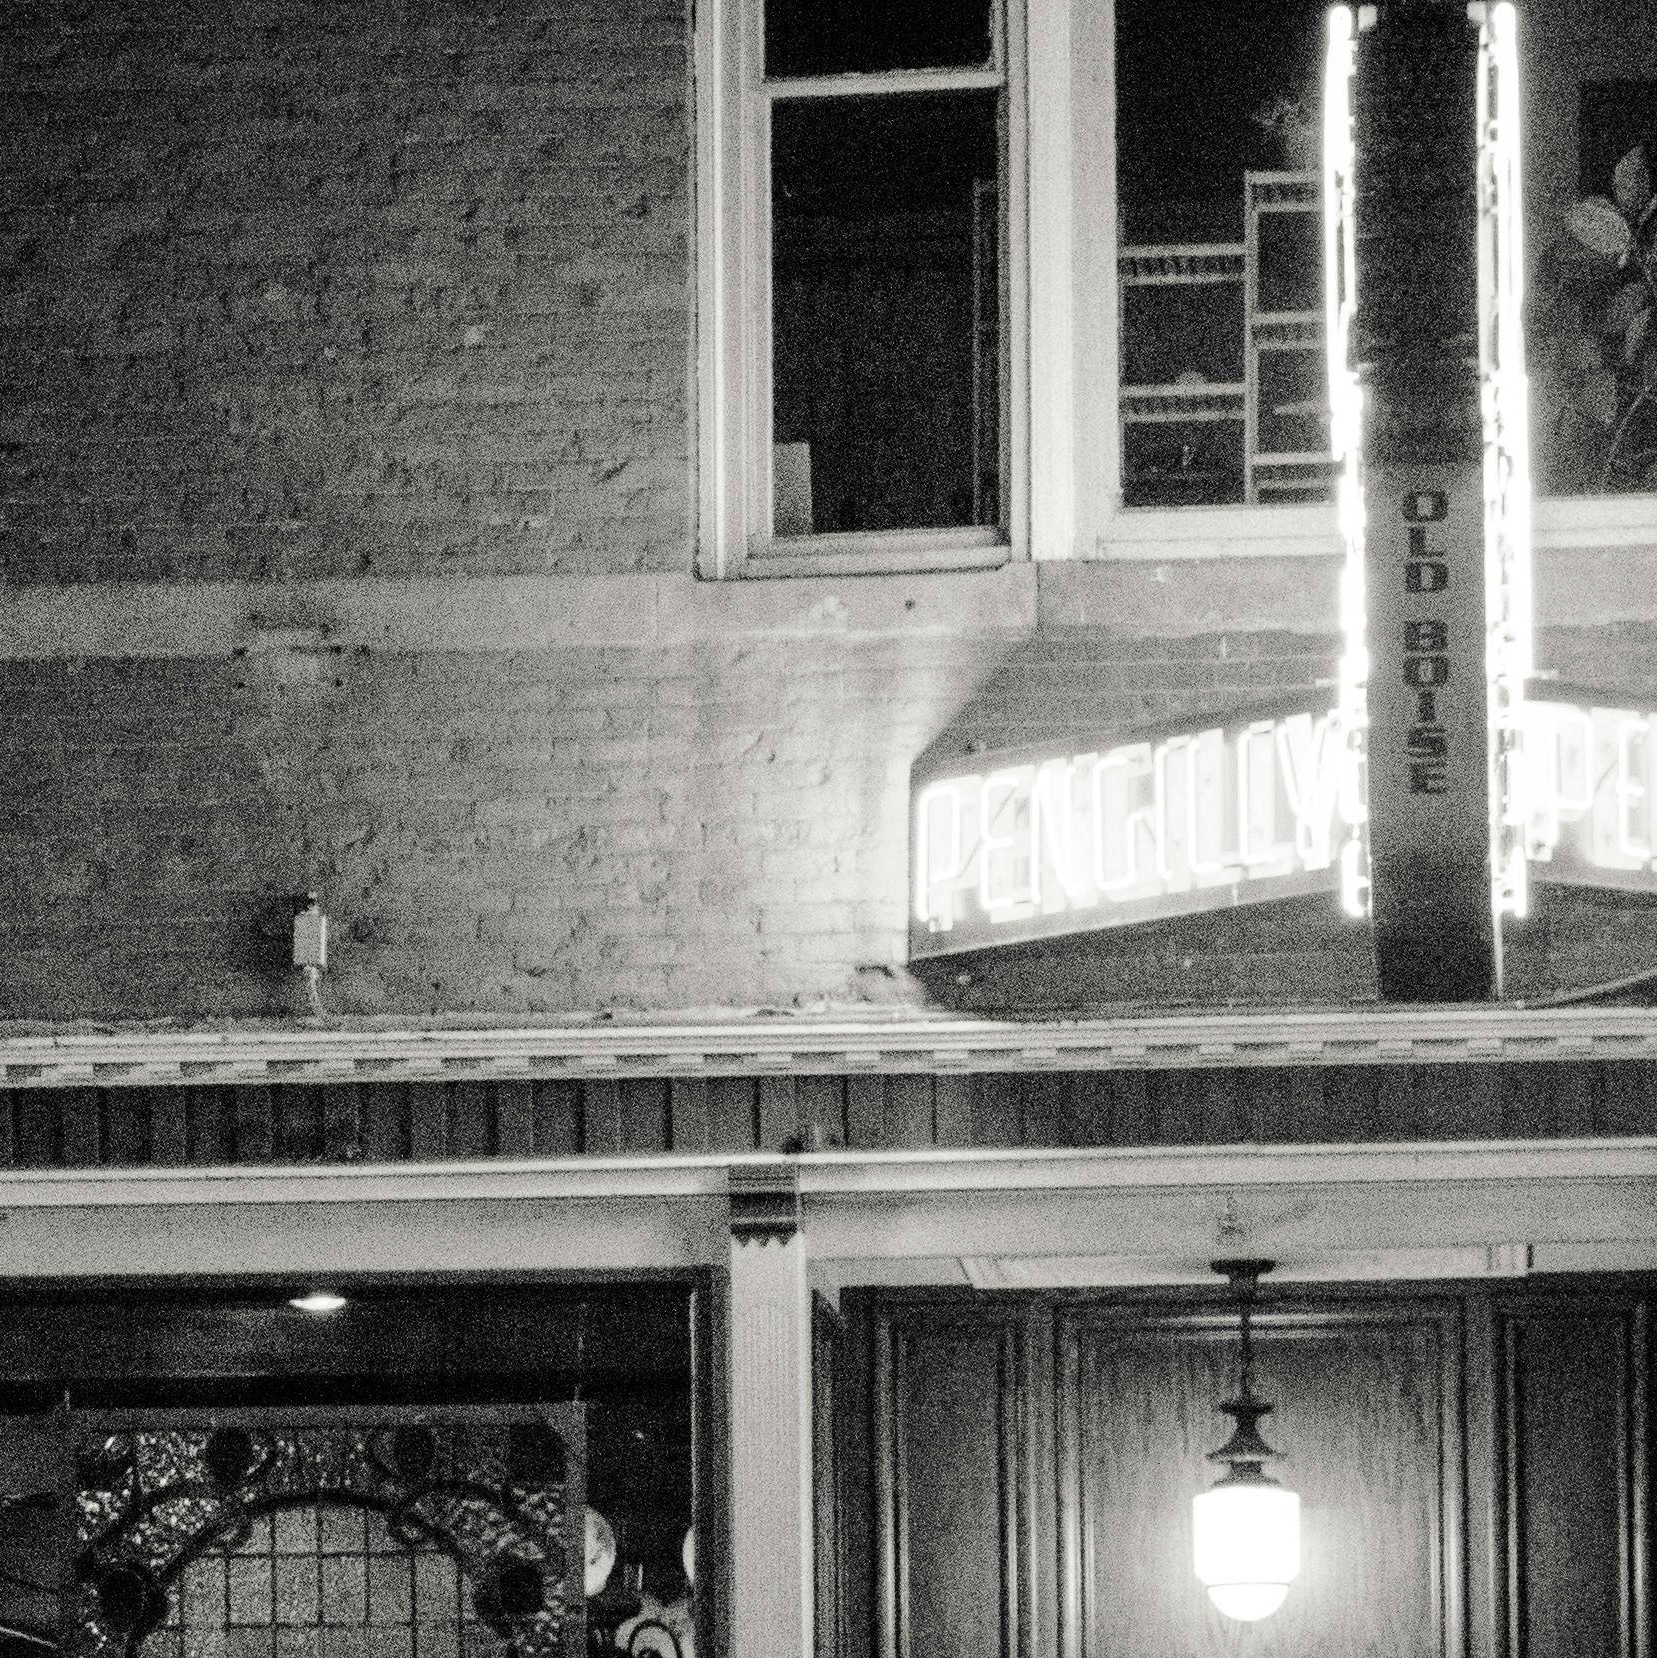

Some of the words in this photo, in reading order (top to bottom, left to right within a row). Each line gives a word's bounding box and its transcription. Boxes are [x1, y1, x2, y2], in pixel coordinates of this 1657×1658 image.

[1402, 490, 1449, 593] OLD
[1402, 620, 1449, 795] BOISE
[916, 708, 1345, 931] PENGILLY
